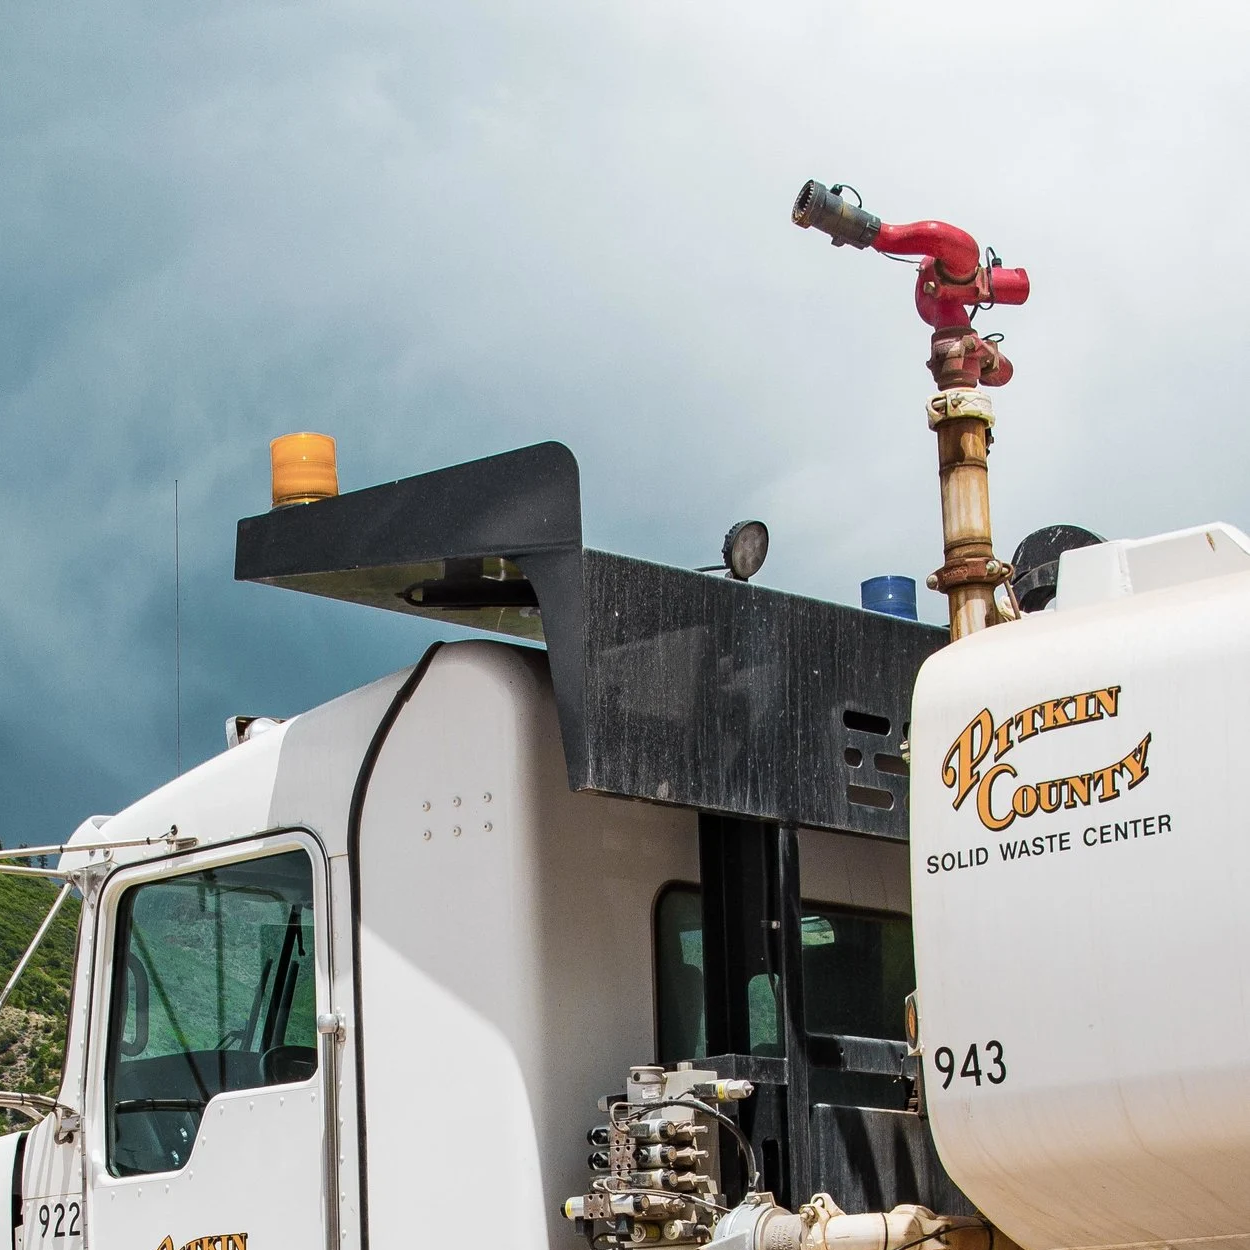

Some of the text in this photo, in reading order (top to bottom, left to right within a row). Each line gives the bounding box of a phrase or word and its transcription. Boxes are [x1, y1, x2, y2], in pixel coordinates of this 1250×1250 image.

[926, 813, 1172, 874] SOLID WASTE CENTER
[934, 1040, 1007, 1090] 943
[39, 1201, 81, 1238] 922
